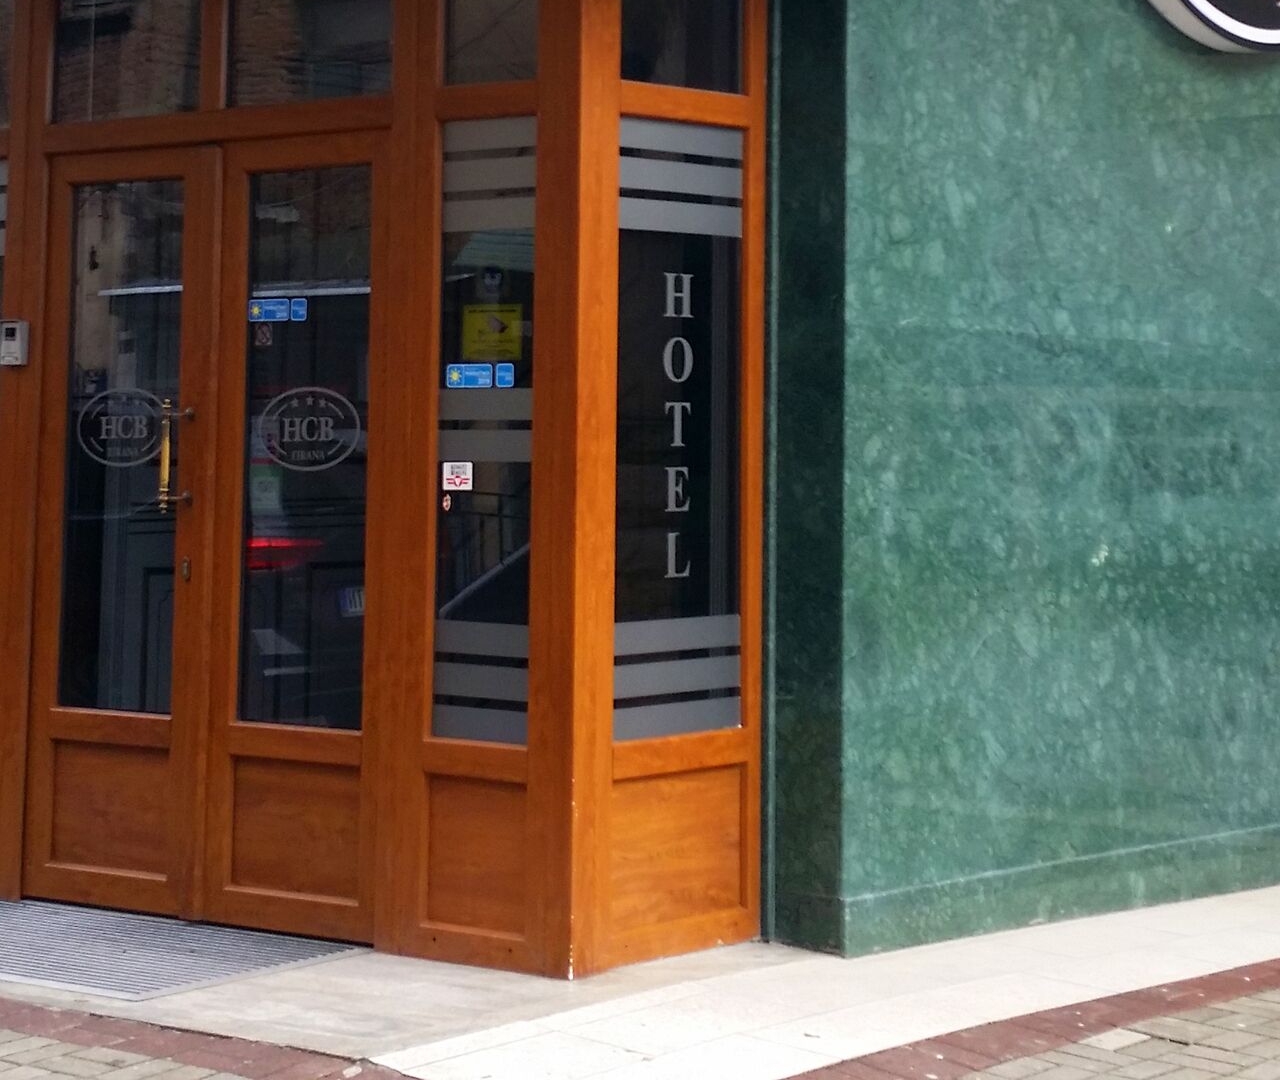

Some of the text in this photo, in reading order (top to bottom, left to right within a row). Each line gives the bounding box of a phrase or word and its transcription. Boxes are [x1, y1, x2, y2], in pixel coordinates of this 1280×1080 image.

[100, 415, 148, 440] HCB
[282, 416, 336, 442] HCB
[662, 271, 694, 580] HOTEL
